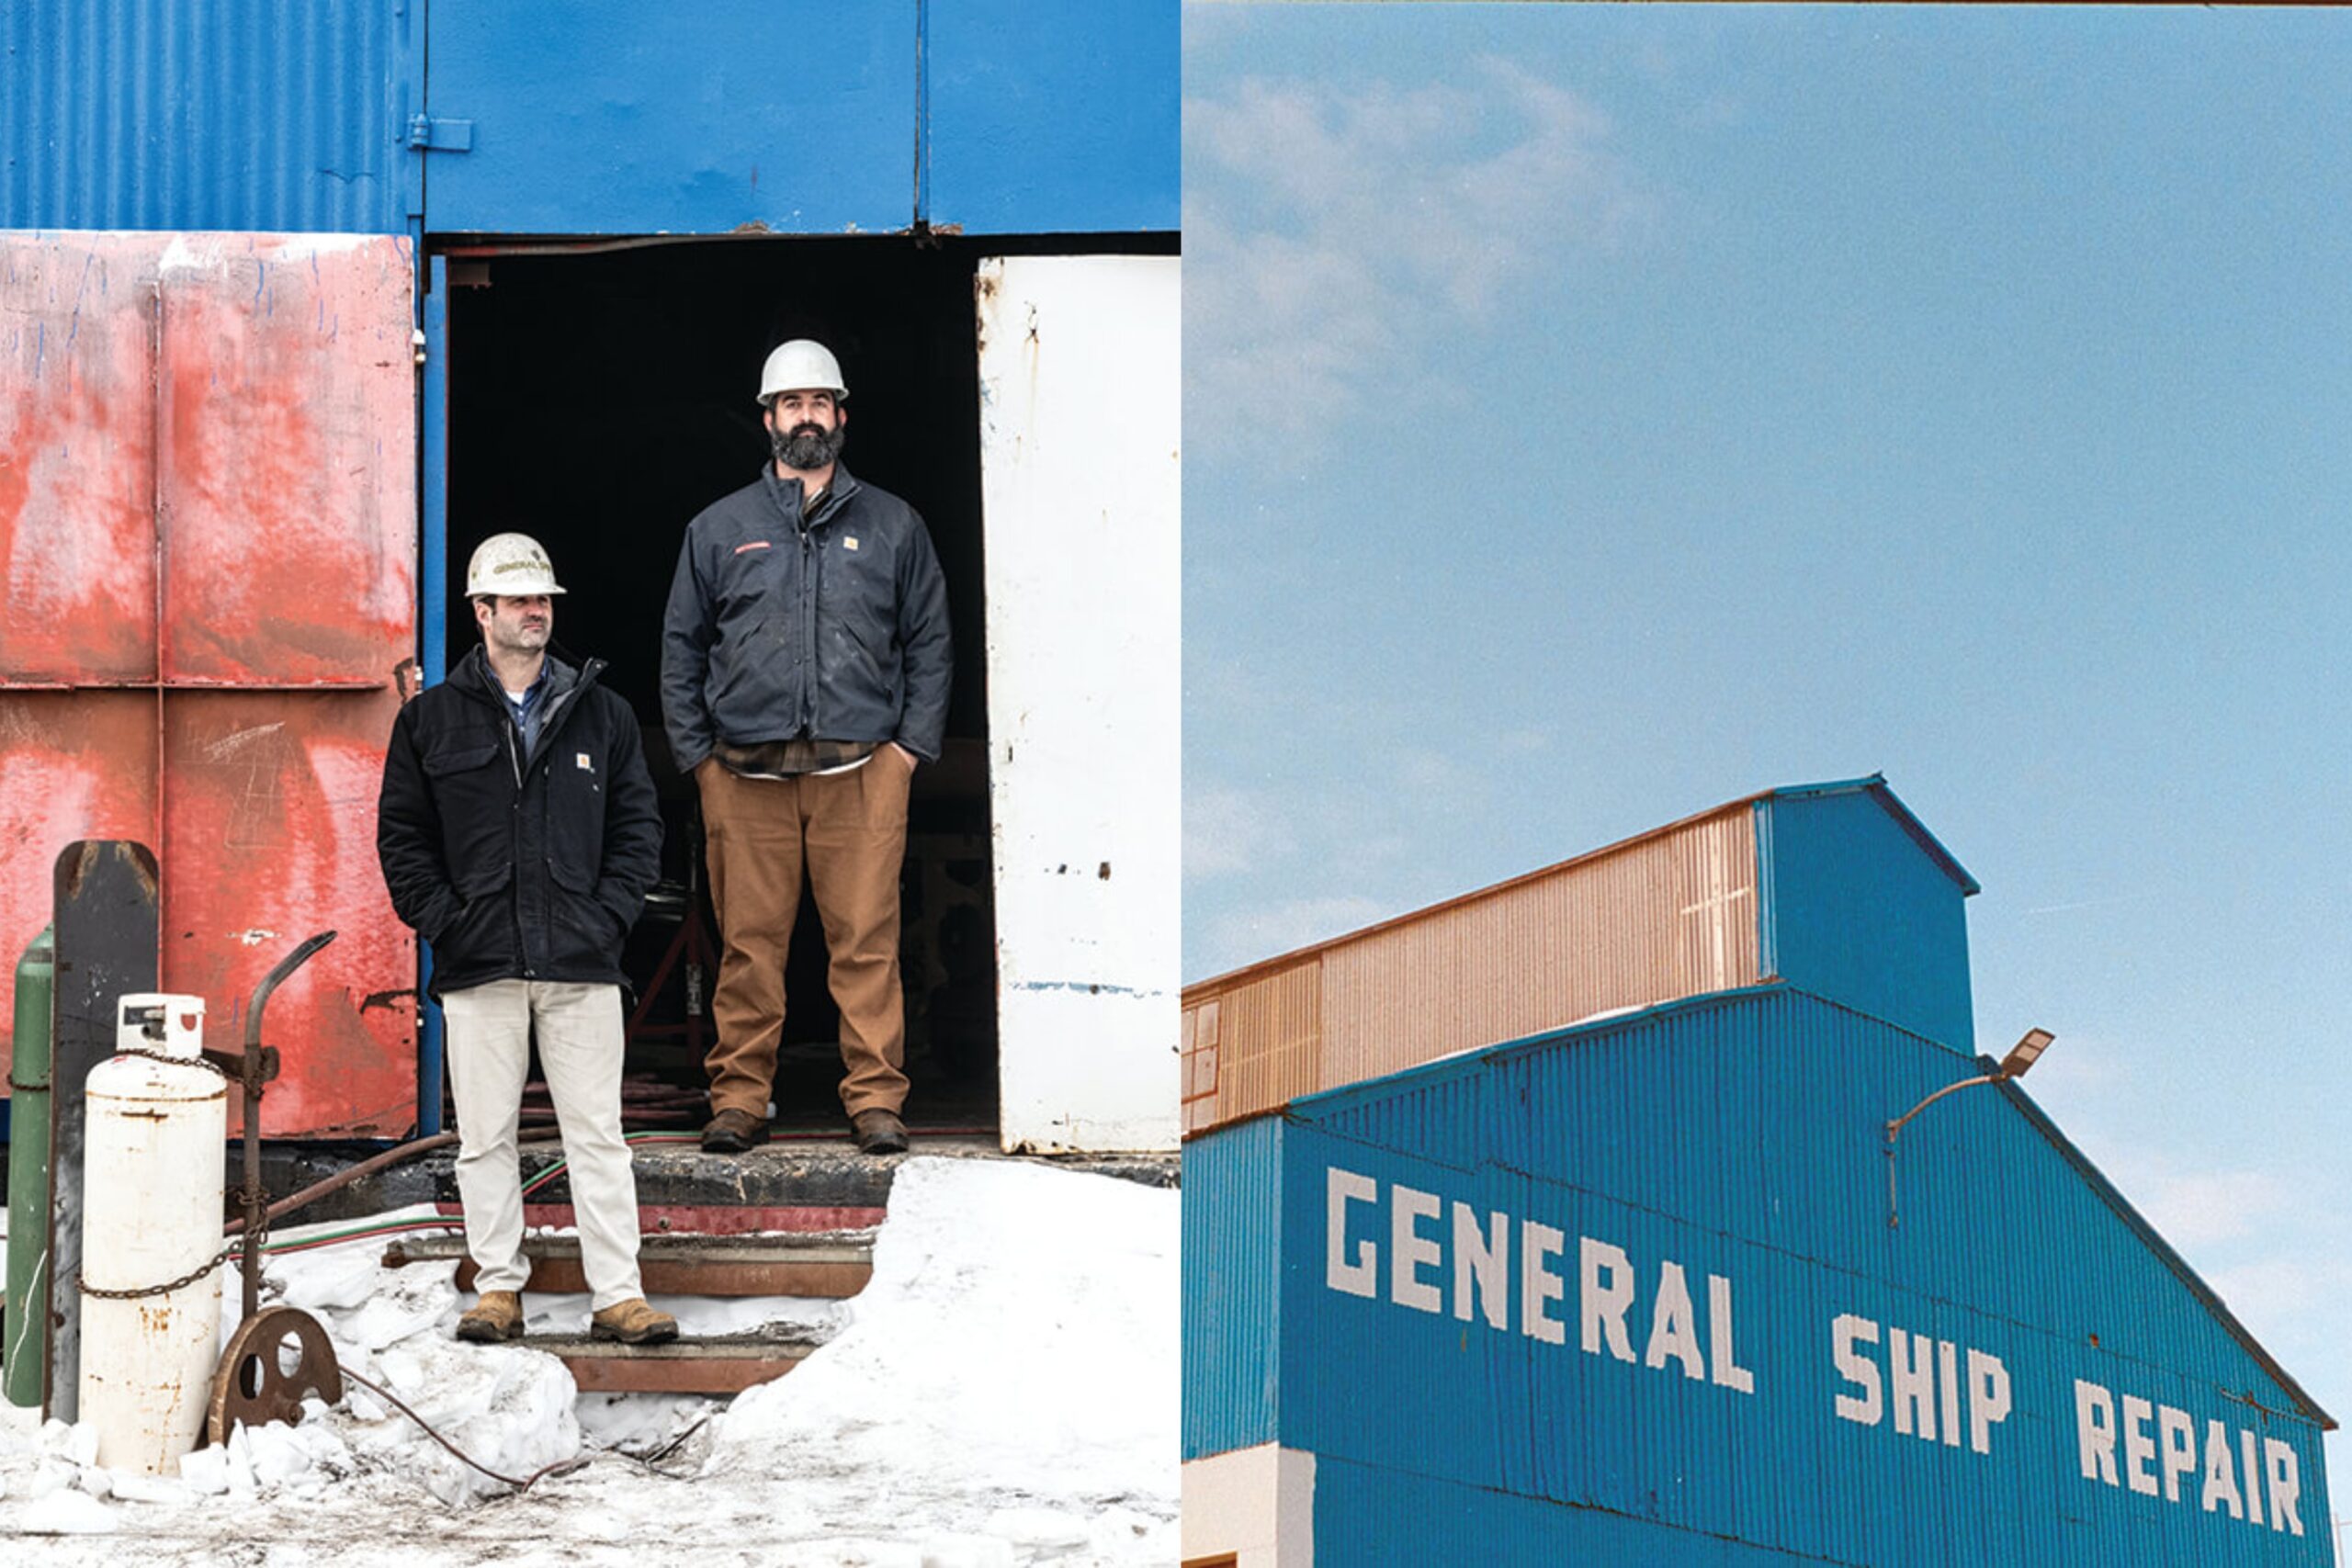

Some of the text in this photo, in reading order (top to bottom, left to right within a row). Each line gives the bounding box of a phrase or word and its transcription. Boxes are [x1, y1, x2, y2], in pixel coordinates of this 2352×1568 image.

[1327, 1167, 2304, 1536] GENERAL SHIP REPAIR
